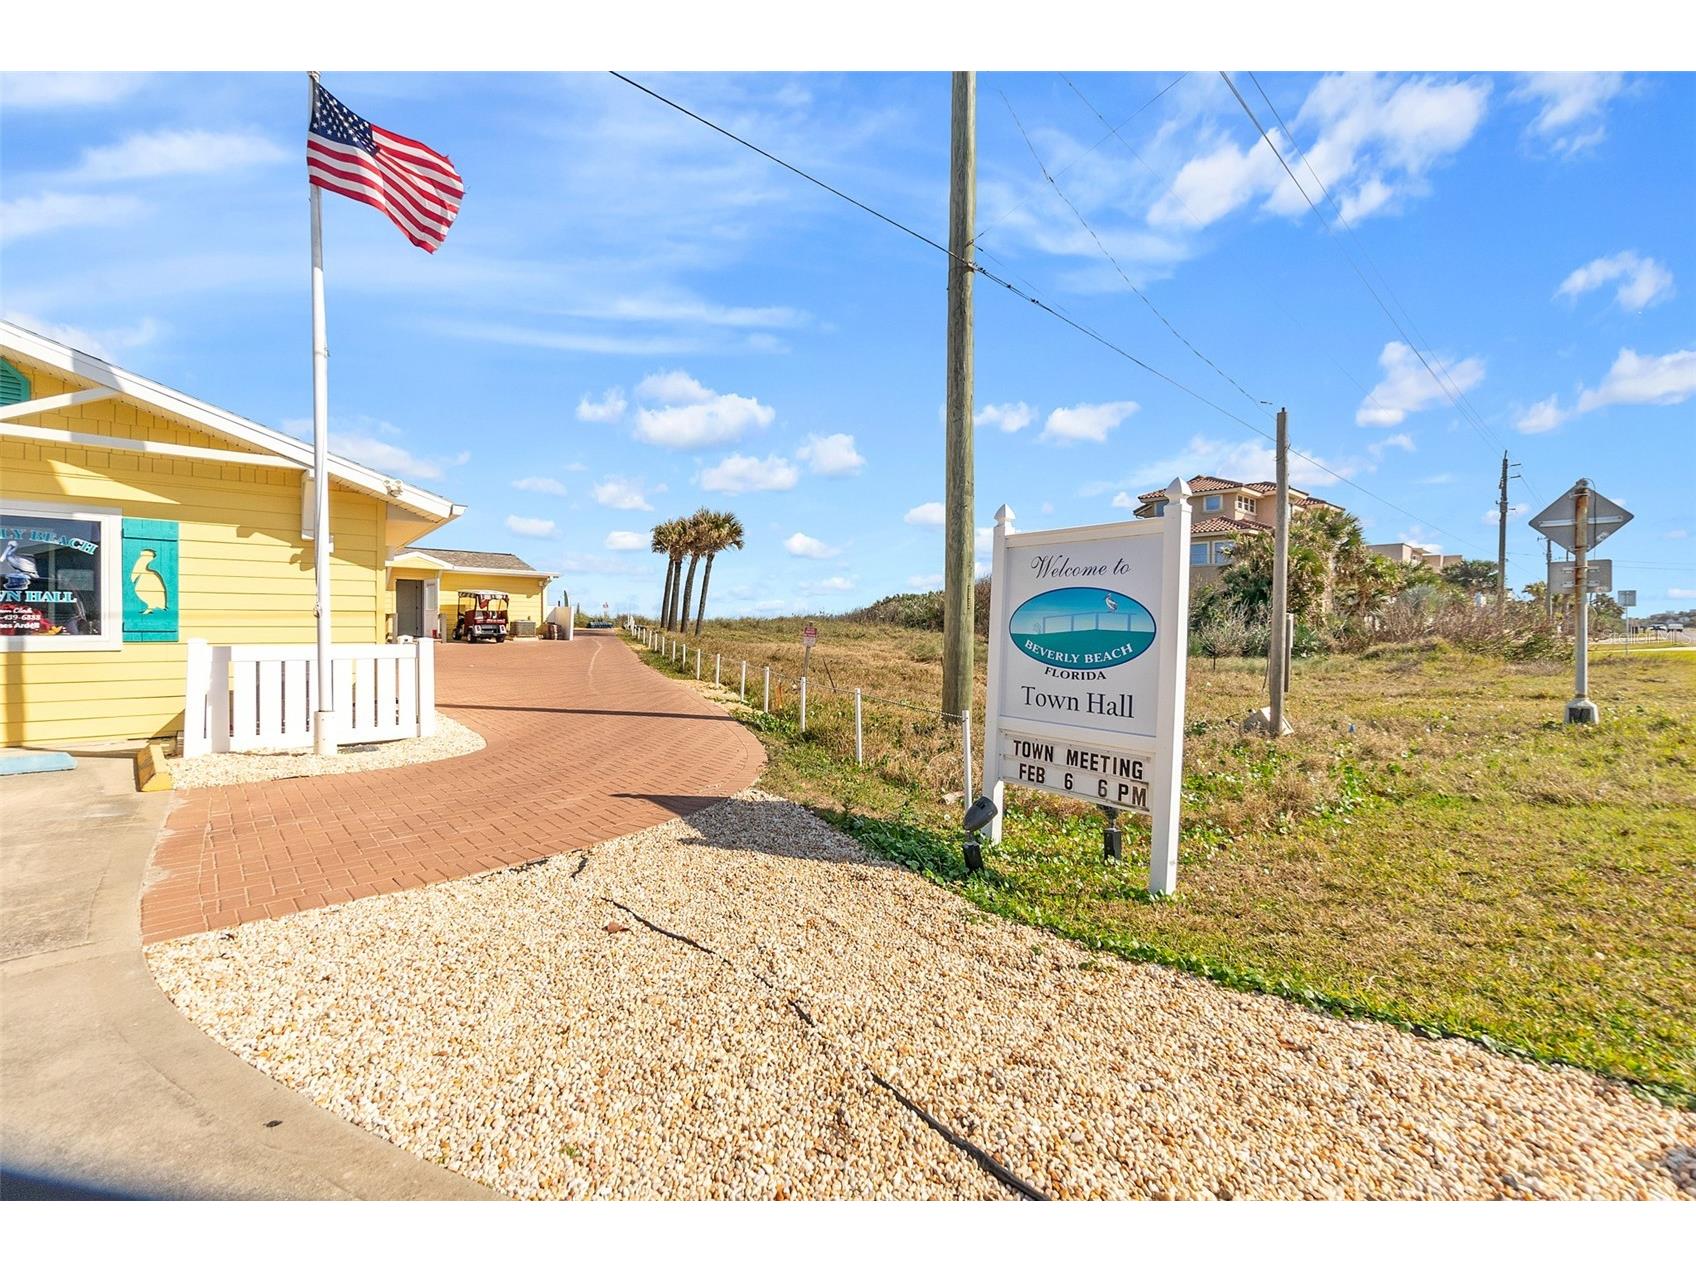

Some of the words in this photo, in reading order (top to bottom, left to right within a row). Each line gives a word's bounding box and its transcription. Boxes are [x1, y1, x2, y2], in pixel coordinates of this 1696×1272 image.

[29, 529, 99, 555] BEACH
[1031, 555, 1107, 579] Welcome
[1113, 558, 1132, 576] to
[25, 590, 77, 603] HALL
[1024, 639, 1080, 664] BEVERLY
[1084, 643, 1133, 664] BEACH
[1044, 666, 1107, 680] FLORIDA
[1021, 685, 1080, 712] Town
[1086, 692, 1135, 718] Hall
[1013, 740, 1054, 763] TOWN
[1066, 749, 1143, 780] MEETING
[1019, 763, 1045, 784] FEB
[1064, 773, 1073, 790] 6
[1098, 779, 1107, 798] 6
[1118, 784, 1147, 807] PM
